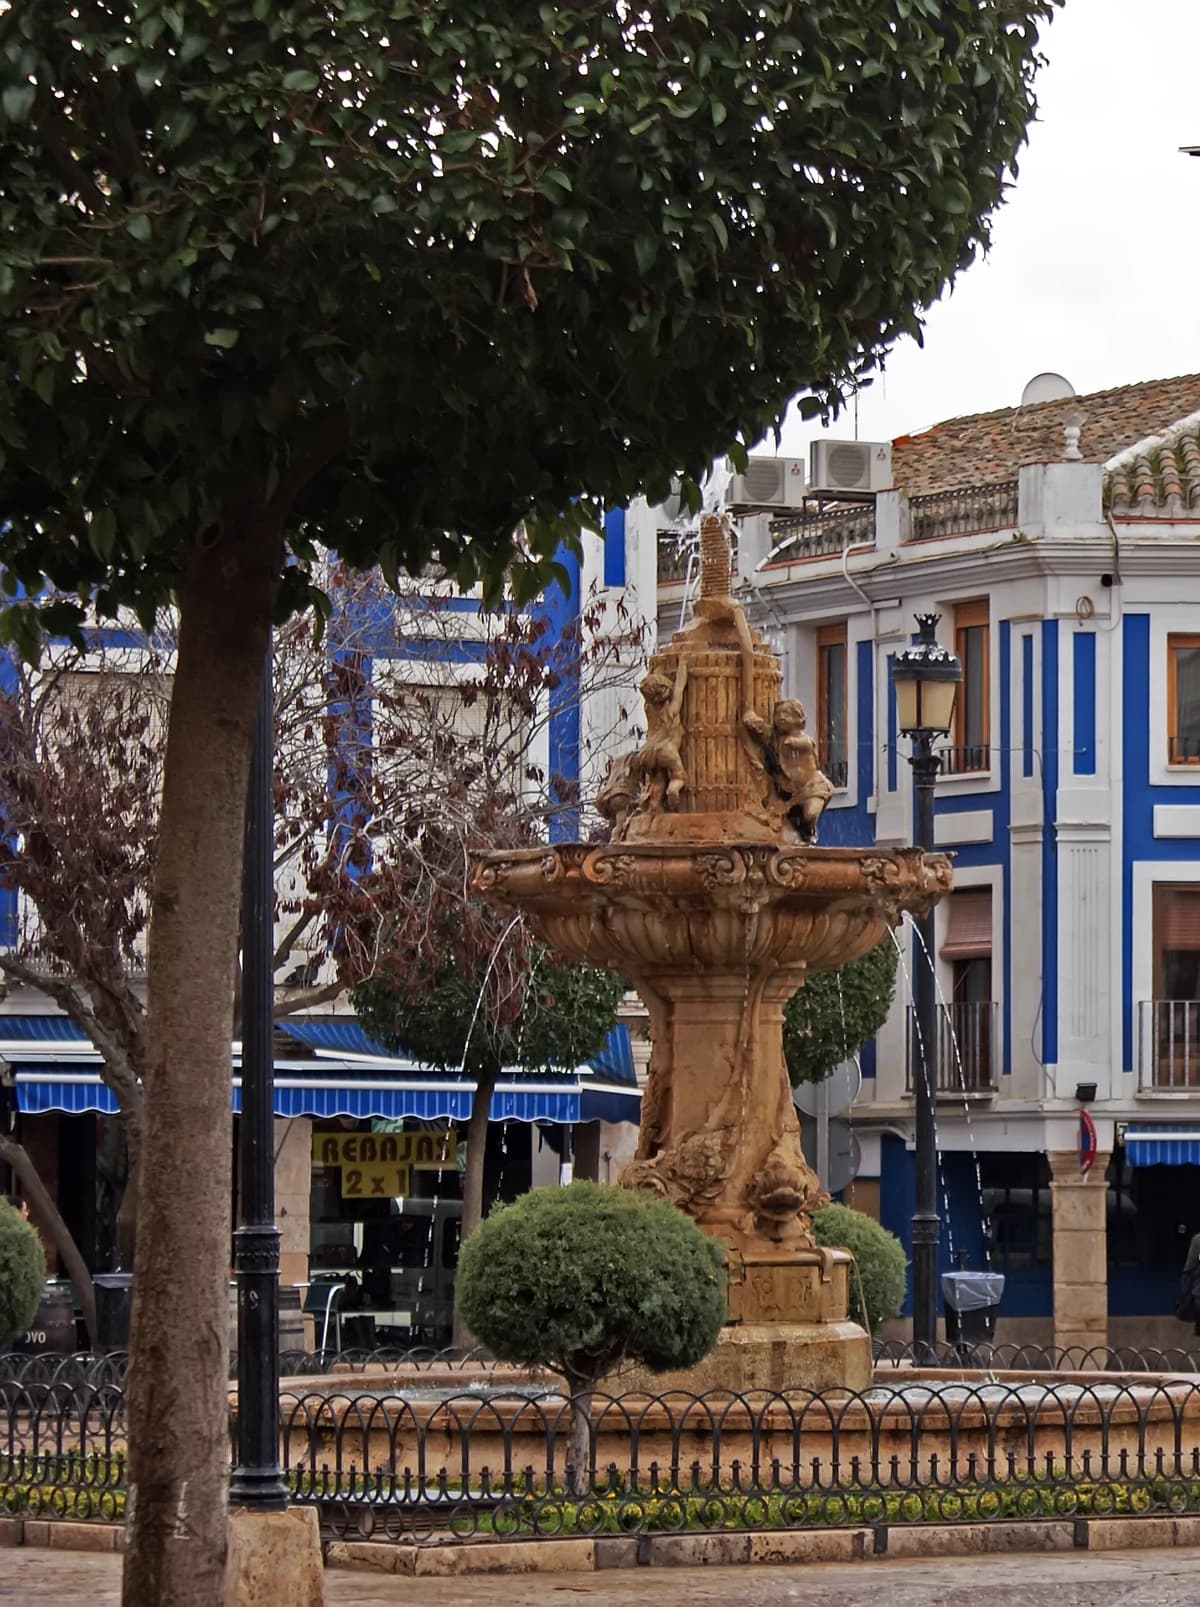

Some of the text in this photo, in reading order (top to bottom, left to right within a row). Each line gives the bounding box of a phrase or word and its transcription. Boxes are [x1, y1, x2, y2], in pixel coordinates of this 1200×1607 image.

[322, 1136, 450, 1163] REBAJAS
[346, 1170, 363, 1195] 2
[396, 1169, 407, 1194] 1
